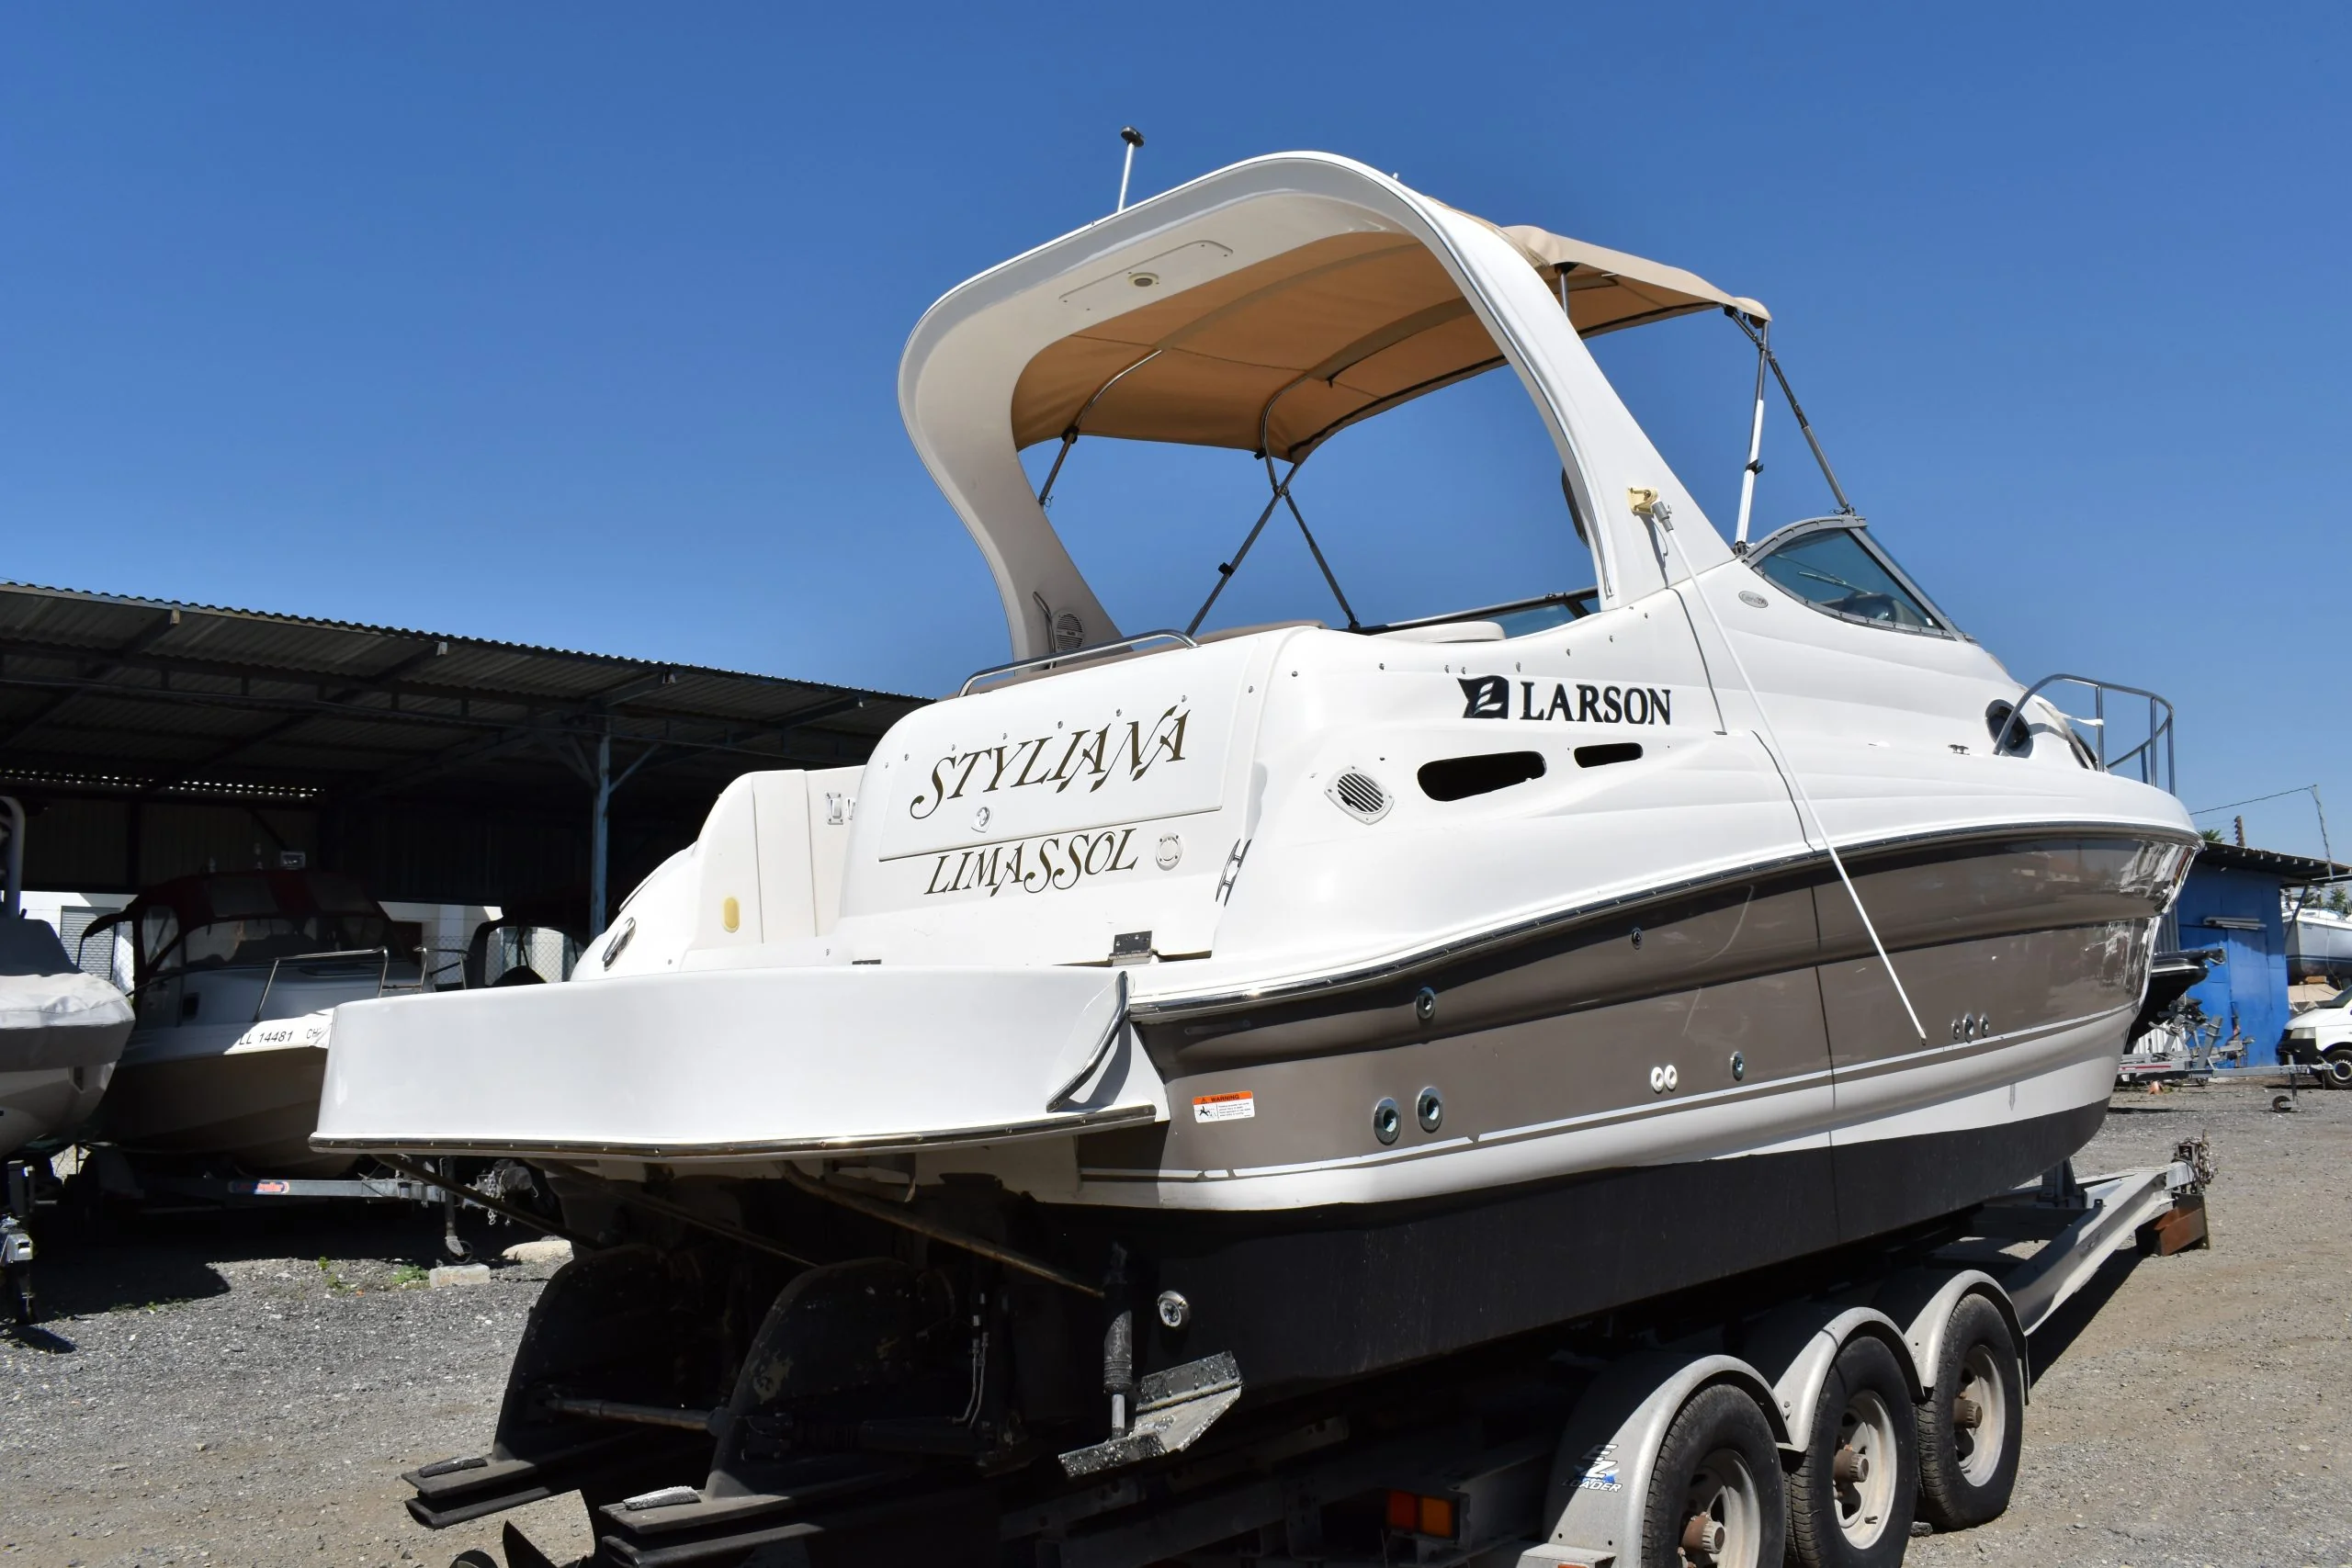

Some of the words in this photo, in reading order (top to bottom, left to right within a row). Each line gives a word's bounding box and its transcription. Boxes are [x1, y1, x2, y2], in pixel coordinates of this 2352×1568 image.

[1520, 681, 1672, 726] LARSON
[910, 705, 1191, 819] STYLIANA
[923, 829, 1139, 897] LIMASSOL
[259, 1031, 294, 1043] 14481
[1211, 1094, 1239, 1102] WARNING
[1560, 1479, 1623, 1493] LOADER
